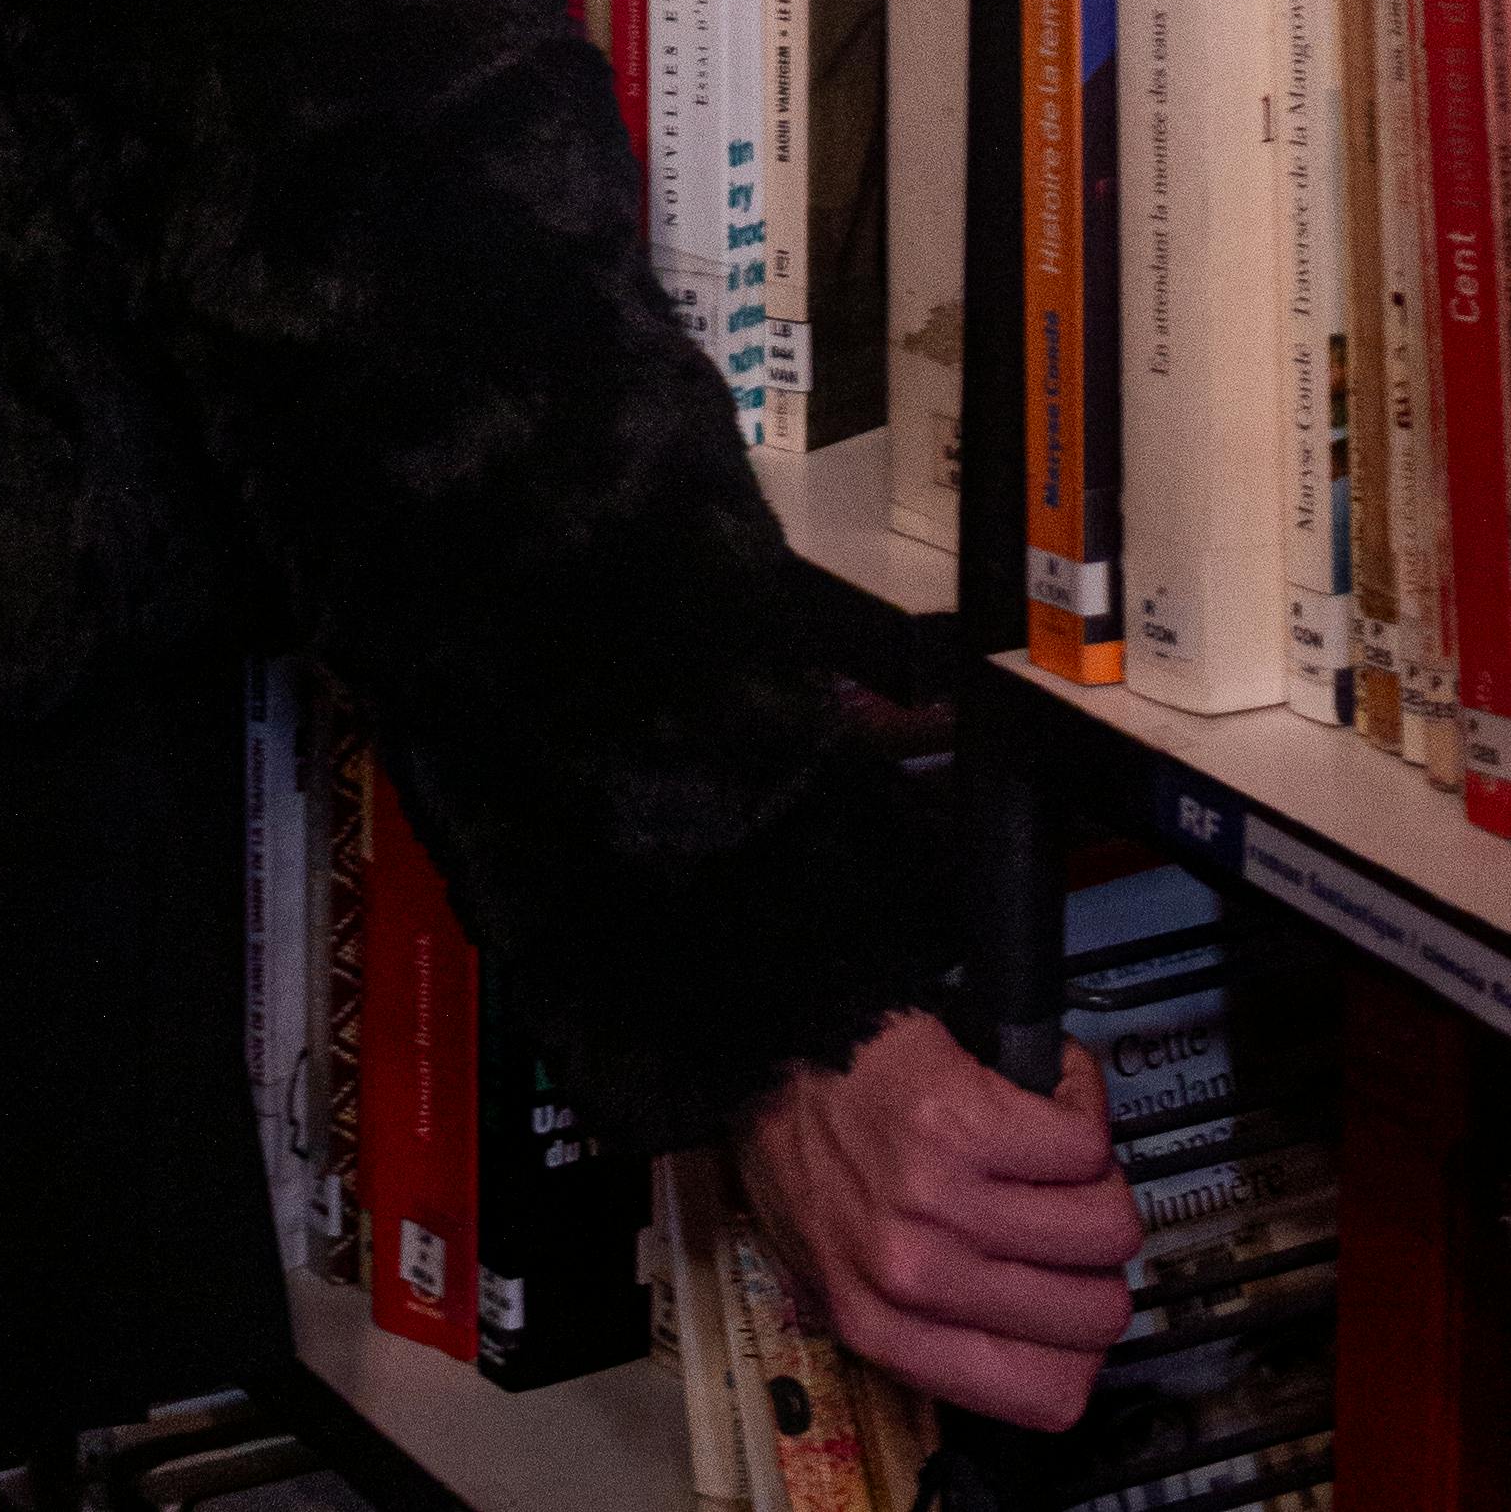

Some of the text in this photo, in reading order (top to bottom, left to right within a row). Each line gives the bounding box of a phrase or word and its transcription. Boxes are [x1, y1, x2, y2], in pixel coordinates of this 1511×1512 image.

[1036, 60, 1060, 93] la
[663, 44, 679, 227] NOUVELLES
[775, 118, 792, 164] RAOUL
[1037, 102, 1061, 141] de
[1287, 127, 1309, 147] la
[1147, 9, 1171, 377] En attendant la montée des eaux
[1288, 158, 1310, 190] de
[1037, 146, 1063, 275] Histoire
[1286, 196, 1315, 317] Traversée
[1446, 230, 1481, 326] Cent
[1291, 341, 1318, 534] Maryse Condé
[1142, 598, 1156, 616] R
[1142, 621, 1178, 646] CON
[1291, 624, 1324, 649] CON
[1178, 794, 1223, 842] RF
[1110, 1024, 1210, 1079] Cette
[1143, 1163, 1290, 1233] lumière
